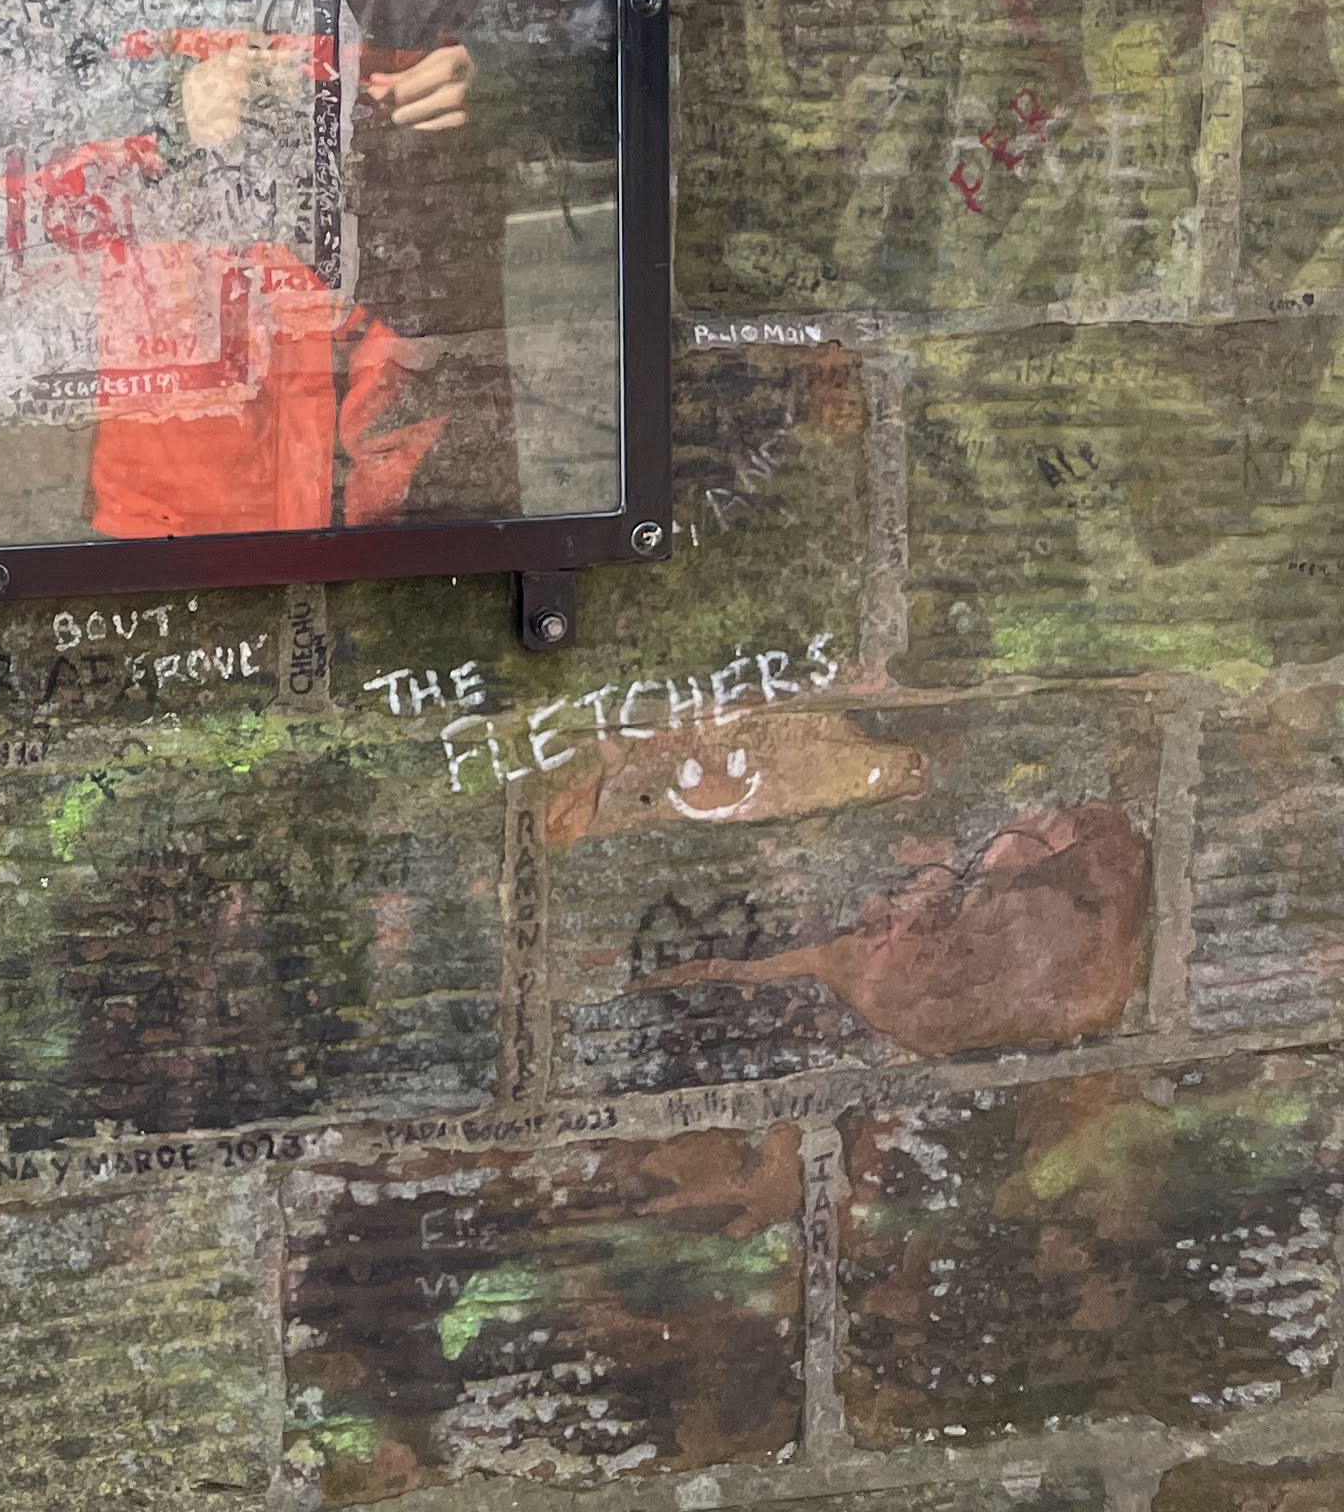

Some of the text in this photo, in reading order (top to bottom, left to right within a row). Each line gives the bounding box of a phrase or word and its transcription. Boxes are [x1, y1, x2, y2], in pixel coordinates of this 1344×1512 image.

[362, 660, 487, 718] THE
[439, 632, 840, 794] FLETCHERS
[215, 1133, 307, 1169] 2023
